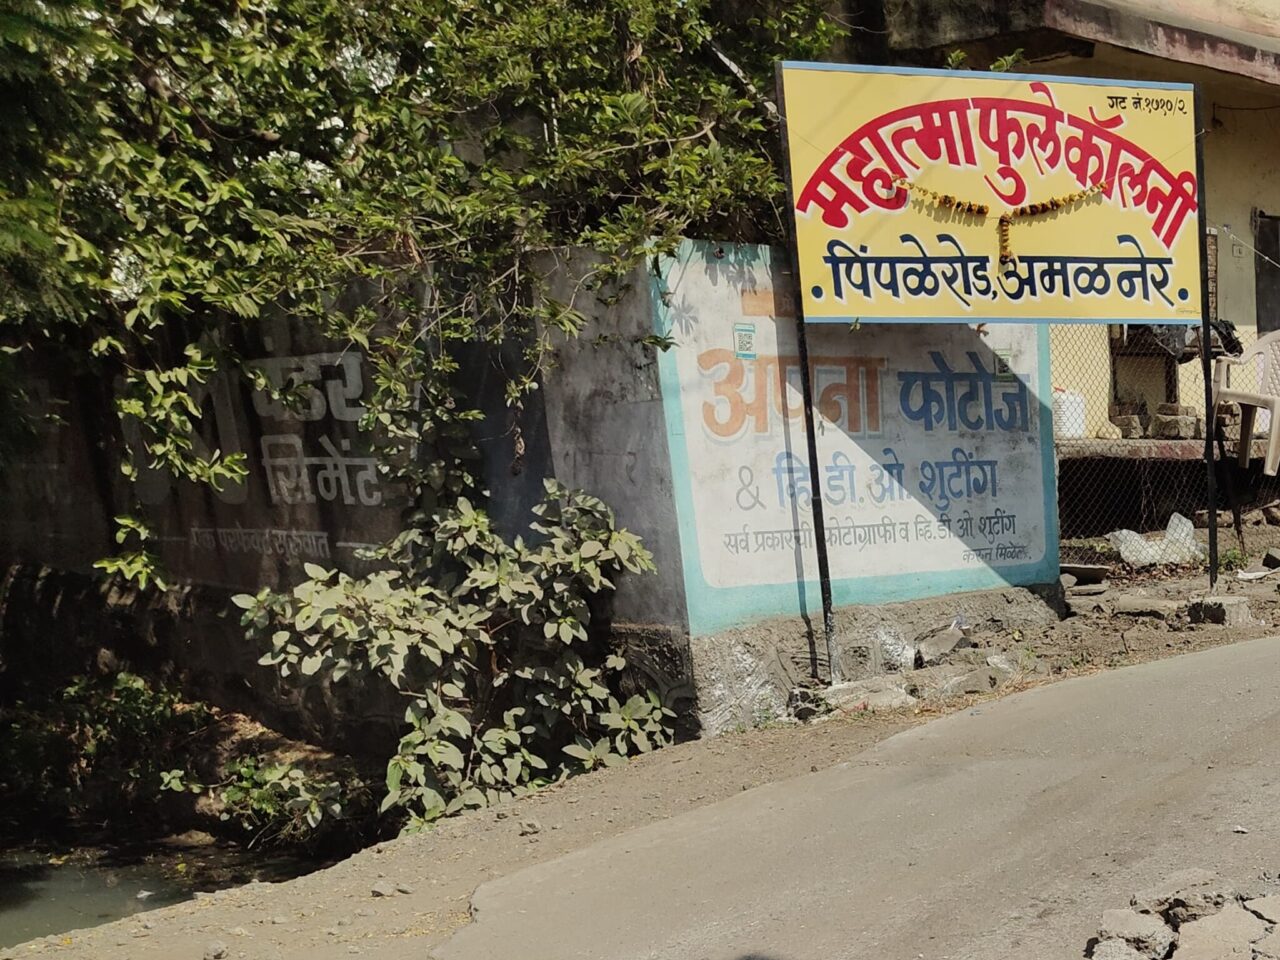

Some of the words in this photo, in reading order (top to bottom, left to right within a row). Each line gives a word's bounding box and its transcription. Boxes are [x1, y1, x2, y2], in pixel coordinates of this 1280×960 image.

[1107, 96, 1128, 110] गट
[796, 98, 977, 229] महात्मा
[970, 82, 1062, 205] फुले
[1065, 106, 1198, 249] कॉलनी
[999, 234, 1174, 307] अमळनेर
[697, 349, 887, 439] अपना
[261, 434, 383, 506] सिमेंट
[736, 466, 766, 511] &
[724, 524, 750, 555] सर्व
[899, 522, 910, 543] व
